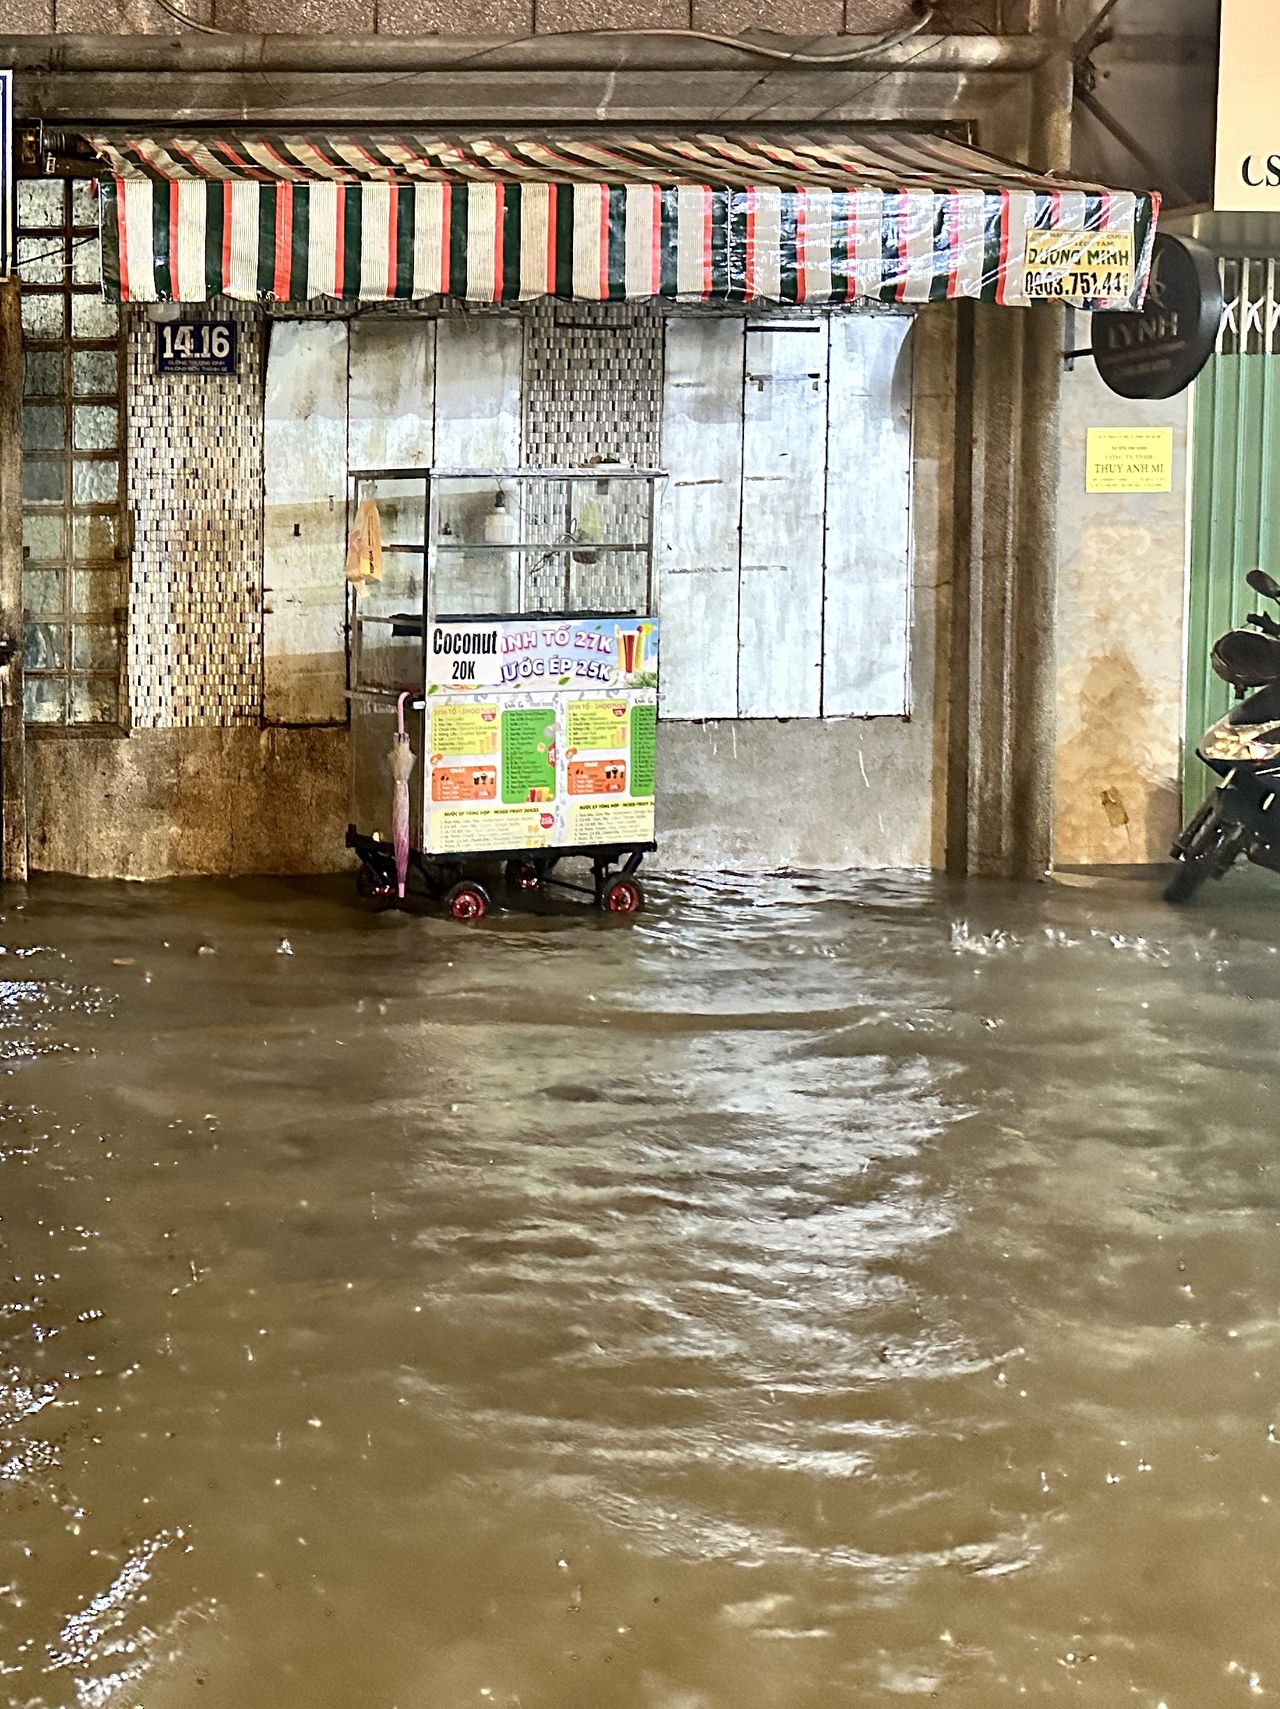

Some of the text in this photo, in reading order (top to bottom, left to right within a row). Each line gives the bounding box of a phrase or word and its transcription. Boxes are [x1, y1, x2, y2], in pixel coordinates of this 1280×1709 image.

[433, 627, 498, 655] Coconut
[501, 624, 614, 654] INH TỐ 27K
[452, 660, 476, 680] 20K
[549, 654, 573, 675] ÉP
[576, 659, 612, 682] 25K
